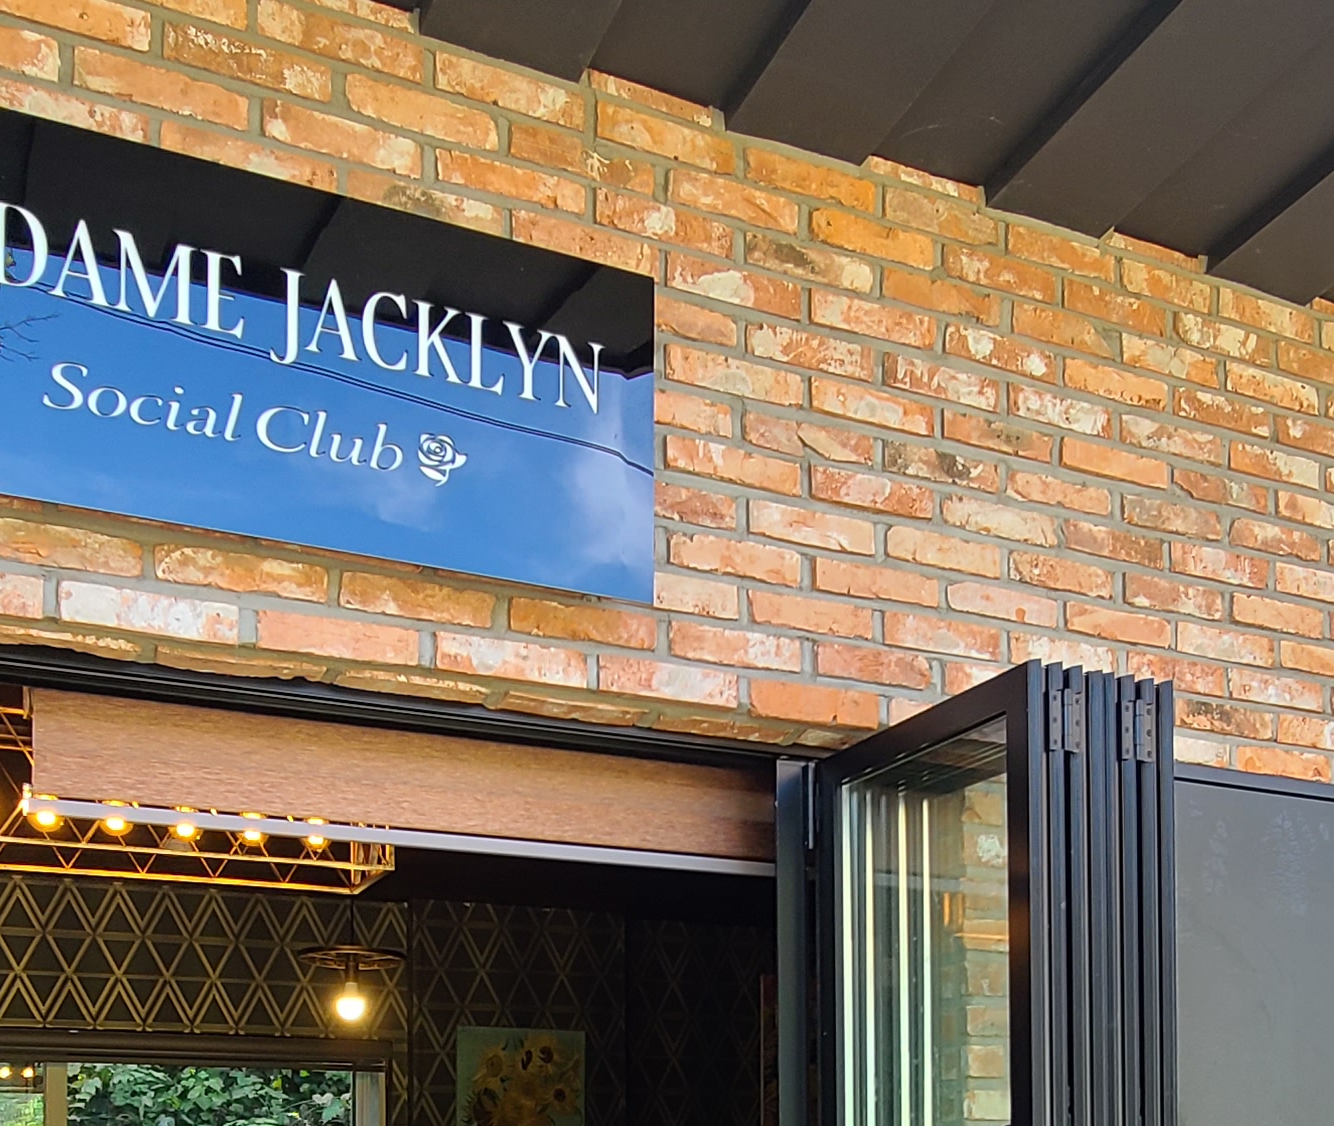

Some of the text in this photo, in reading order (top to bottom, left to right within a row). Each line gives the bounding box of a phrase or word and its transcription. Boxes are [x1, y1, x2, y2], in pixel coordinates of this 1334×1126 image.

[269, 267, 604, 415] JACKLYN
[42, 361, 404, 473] Social Club
